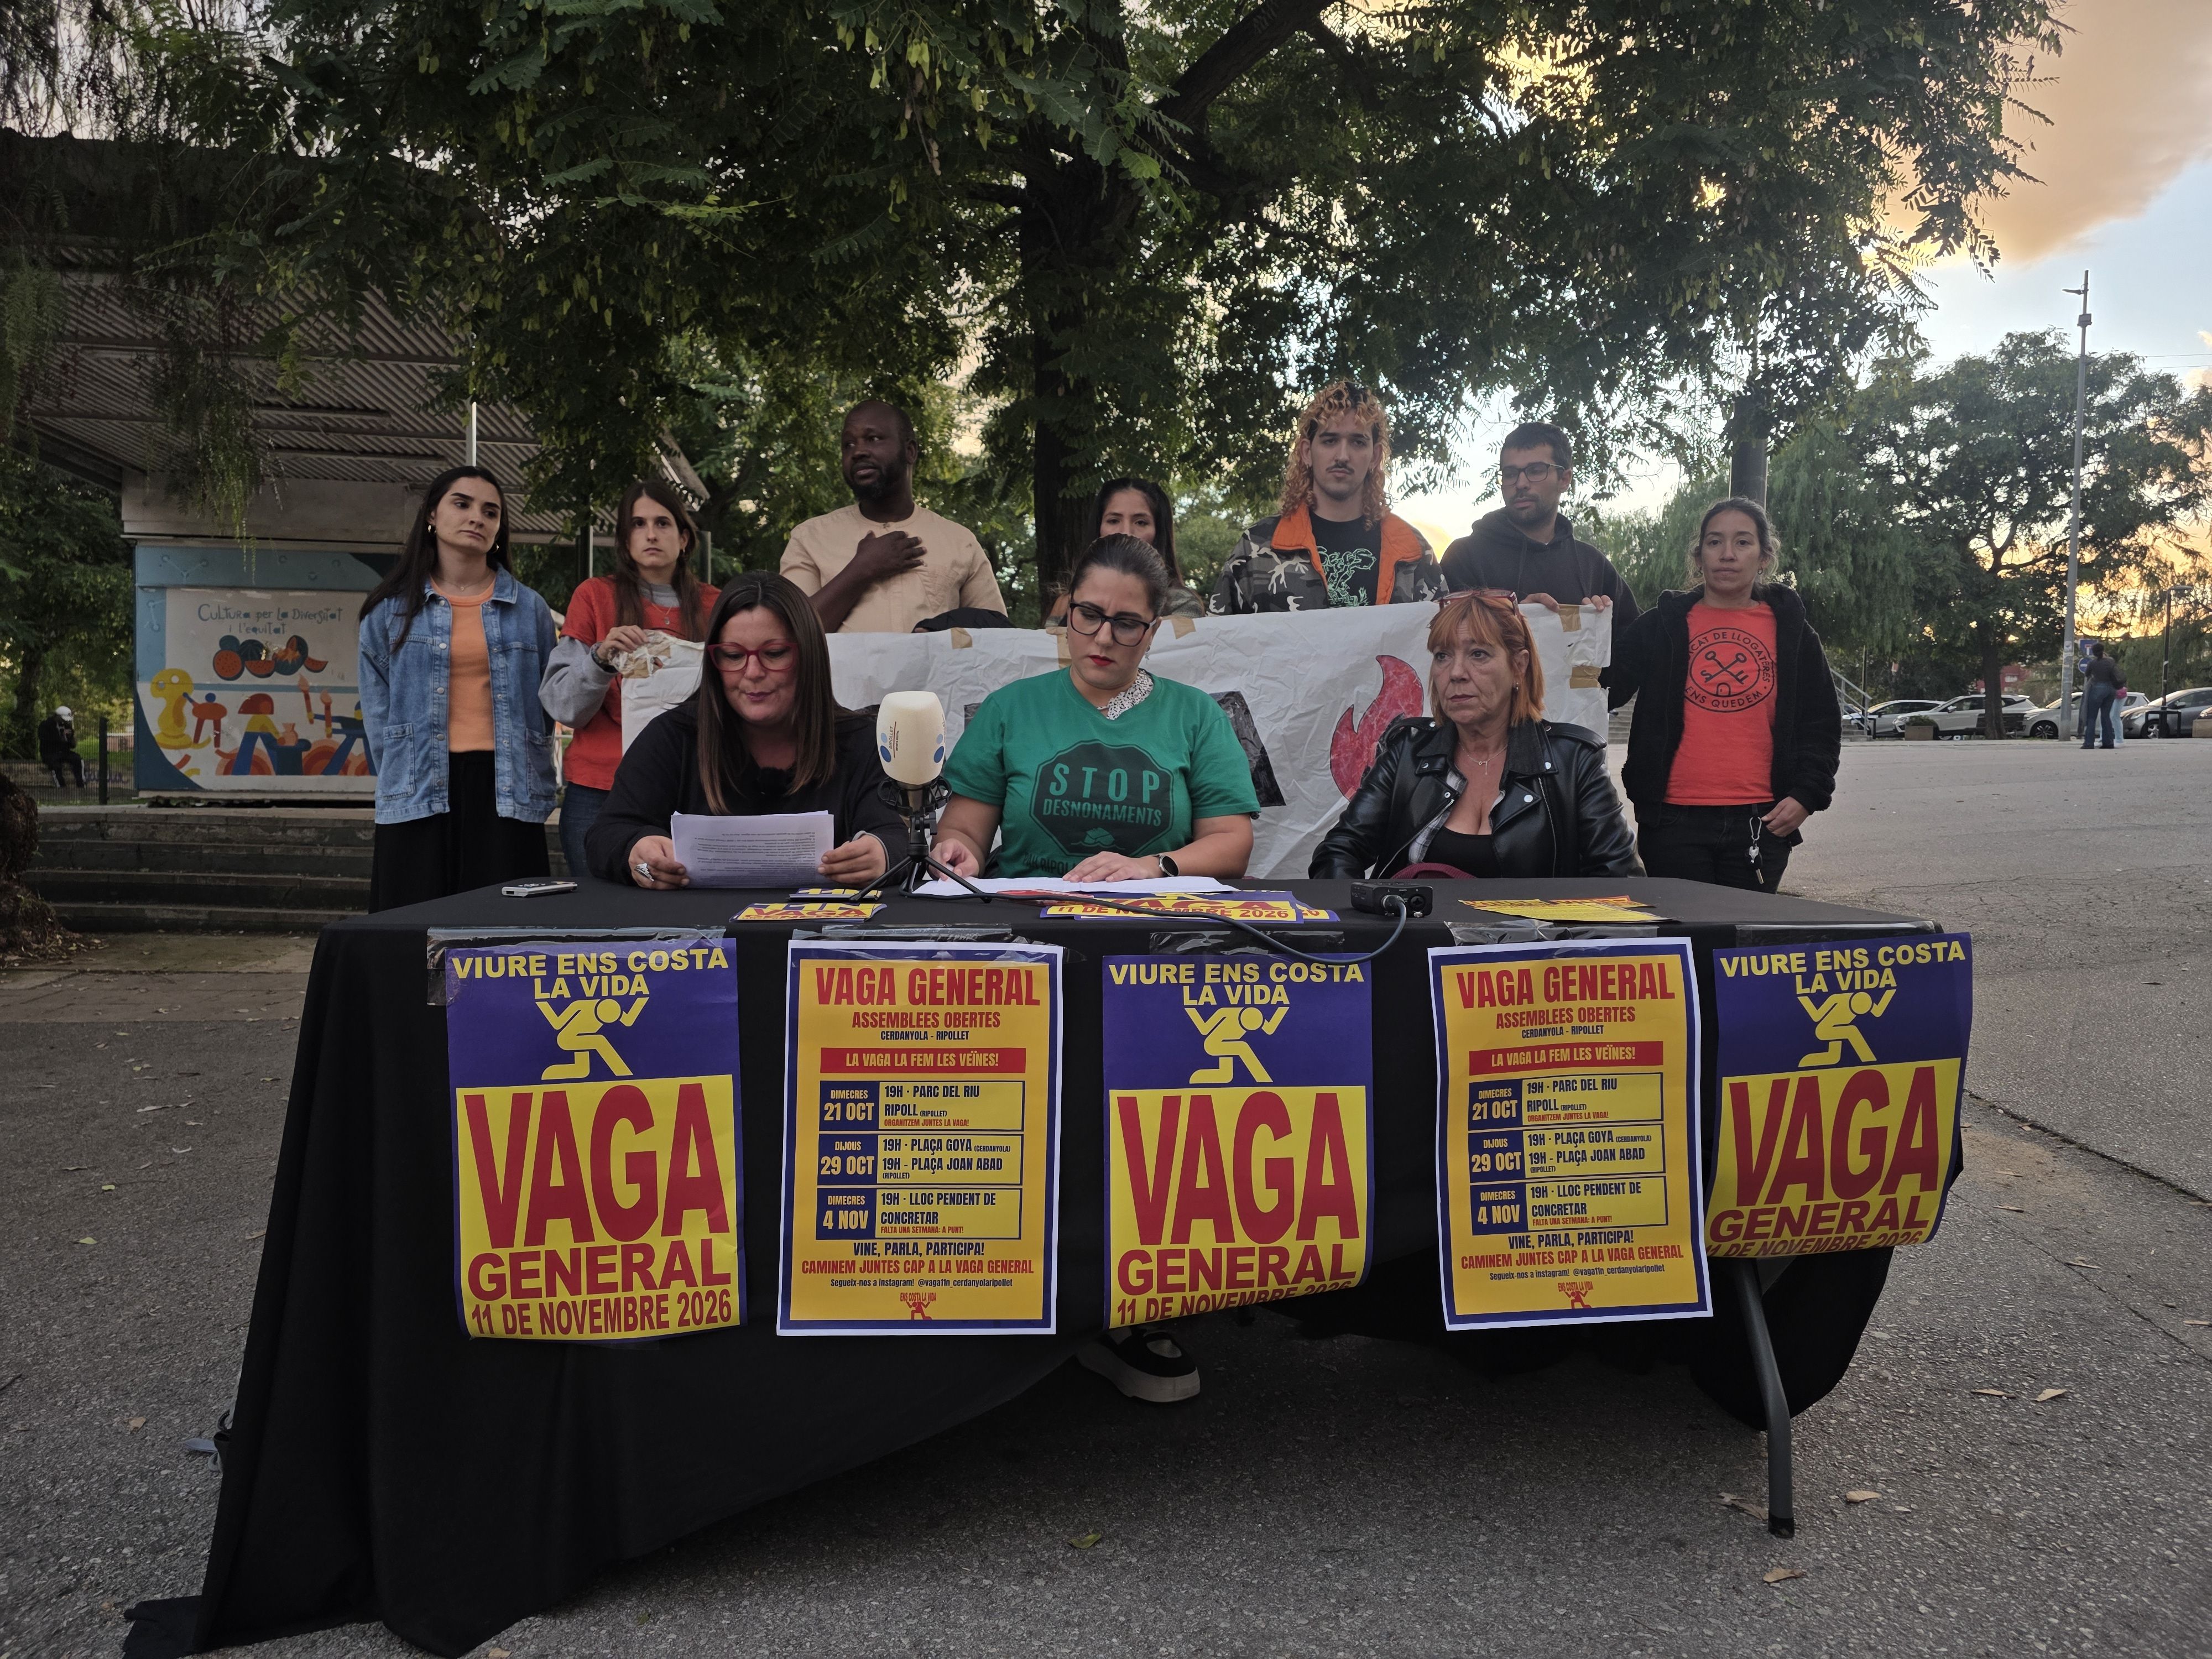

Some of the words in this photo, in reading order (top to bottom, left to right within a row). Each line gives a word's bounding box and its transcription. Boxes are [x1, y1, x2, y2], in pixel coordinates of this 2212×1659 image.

[256, 611, 273, 622] per
[1731, 633, 1770, 683] LLOGATERES
[1712, 691, 1762, 708] QUEDEM
[1050, 763, 1160, 804] STOP
[1043, 799, 1162, 826] DESNONAMENTS
[753, 908, 867, 916] VAGA
[1239, 910, 1288, 918] 2026
[452, 955, 547, 979] VIURE
[557, 953, 618, 975] ENS
[628, 948, 728, 972] COSTA
[1720, 953, 1807, 977] VIURE
[1816, 948, 1869, 971] ENS
[1878, 941, 1965, 966] COSTA
[1109, 964, 1195, 984] VIURE
[1205, 963, 1260, 983] ENS
[1270, 962, 1364, 982] COSTA
[1796, 974, 1828, 994] LA
[1835, 968, 1897, 991] VIDA
[534, 977, 571, 999] LA
[579, 974, 649, 997] VIDA
[816, 967, 896, 1005] VAGA
[908, 968, 1040, 1006] GENERAL
[1183, 985, 1217, 1005] LA
[1224, 984, 1290, 1005] VIDA
[1457, 968, 1534, 1009] VAGA
[1544, 963, 1675, 1003] GENERAL
[852, 1012, 939, 1028] ASSEMBLEES
[944, 1011, 1000, 1027] OBERTES
[1496, 1008, 1573, 1029] ASSEMBLEES
[1578, 1006, 1636, 1022] OBERTES
[880, 1031, 928, 1040] CERDANYOLA
[936, 1031, 969, 1040] RIPOLLET
[846, 1053, 859, 1066] LA
[863, 1053, 890, 1066] VAGA
[894, 1053, 907, 1066] LA
[911, 1053, 933, 1066] FEM
[937, 1053, 956, 1066] LES
[959, 1050, 998, 1066] VEÏNES!
[831, 1090, 868, 1099] DIMECRES
[885, 1086, 903, 1098] 19H
[913, 1086, 939, 1098] PARC
[942, 1086, 960, 1098] DEL
[964, 1086, 979, 1097] RIU
[824, 1103, 840, 1120] 21
[846, 1103, 874, 1120] OCT
[884, 1104, 918, 1117] RIPOLL
[1472, 1102, 1488, 1120] 21
[1492, 1100, 1518, 1119] OCT
[1527, 1098, 1558, 1112] RIPOLL
[835, 1141, 862, 1151] DIJOUS
[1527, 1134, 1545, 1146] 19H
[1554, 1132, 1585, 1148] PLAÇA
[1588, 1131, 1614, 1143] GOYA
[1729, 1066, 1939, 1207] VAGA
[883, 1139, 901, 1151] 19H
[911, 1139, 942, 1155] PLAÇA
[946, 1139, 972, 1151] GOYA
[464, 1083, 730, 1249] VAGA
[821, 1156, 842, 1175] 29
[846, 1156, 874, 1175] OCT
[883, 1158, 901, 1170] 19H
[911, 1157, 943, 1174] PLAÇA
[947, 1157, 973, 1170] JOAN
[976, 1157, 1003, 1170] ABAD
[1117, 1091, 1360, 1245] VAGA
[1472, 1154, 1491, 1172] 29
[1495, 1152, 1521, 1171] OCT
[828, 1196, 865, 1205] DIMECRES
[881, 1193, 900, 1206] 19H
[910, 1193, 934, 1205] LLOC
[937, 1193, 980, 1205] PENDENT
[984, 1193, 996, 1205] DE
[822, 1211, 833, 1229] 4
[838, 1211, 868, 1229] NOV
[880, 1212, 938, 1224] CONCRETAR
[1478, 1207, 1487, 1225] 4
[1493, 1204, 1520, 1224] NOV
[1531, 1203, 1587, 1217] CONCRETAR
[1710, 1196, 1929, 1243] GENERAL
[853, 1242, 880, 1257] VINE,
[885, 1242, 922, 1257] PARLA,
[926, 1242, 984, 1256] PARTICIPA!
[1723, 1243, 1754, 1256] DE
[1755, 1234, 1871, 1256] NOVEMBRE
[802, 1260, 855, 1274] CAMINEM
[859, 1260, 900, 1274] JUNTES
[903, 1260, 925, 1274] CAP
[928, 1260, 936, 1274] A
[939, 1260, 952, 1274] LA
[956, 1260, 984, 1274] VAGA
[988, 1260, 1034, 1274] GENERAL
[1461, 1254, 1512, 1270] CAMINEM
[1516, 1253, 1554, 1267] JUNTES
[1557, 1251, 1577, 1266] CAP
[1582, 1250, 1588, 1263] A
[1592, 1250, 1604, 1262] LA
[1607, 1248, 1635, 1261] VAGA
[1637, 1245, 1683, 1260] GENERAL
[468, 1238, 731, 1301] GENERAL
[1118, 1244, 1357, 1296] GENERAL
[472, 1304, 494, 1334] 11
[502, 1303, 533, 1335] DE
[539, 1294, 669, 1335] NOVEMBRE
[677, 1288, 731, 1327] 2026
[1117, 1298, 1137, 1324] 11
[1144, 1296, 1173, 1322] DE
